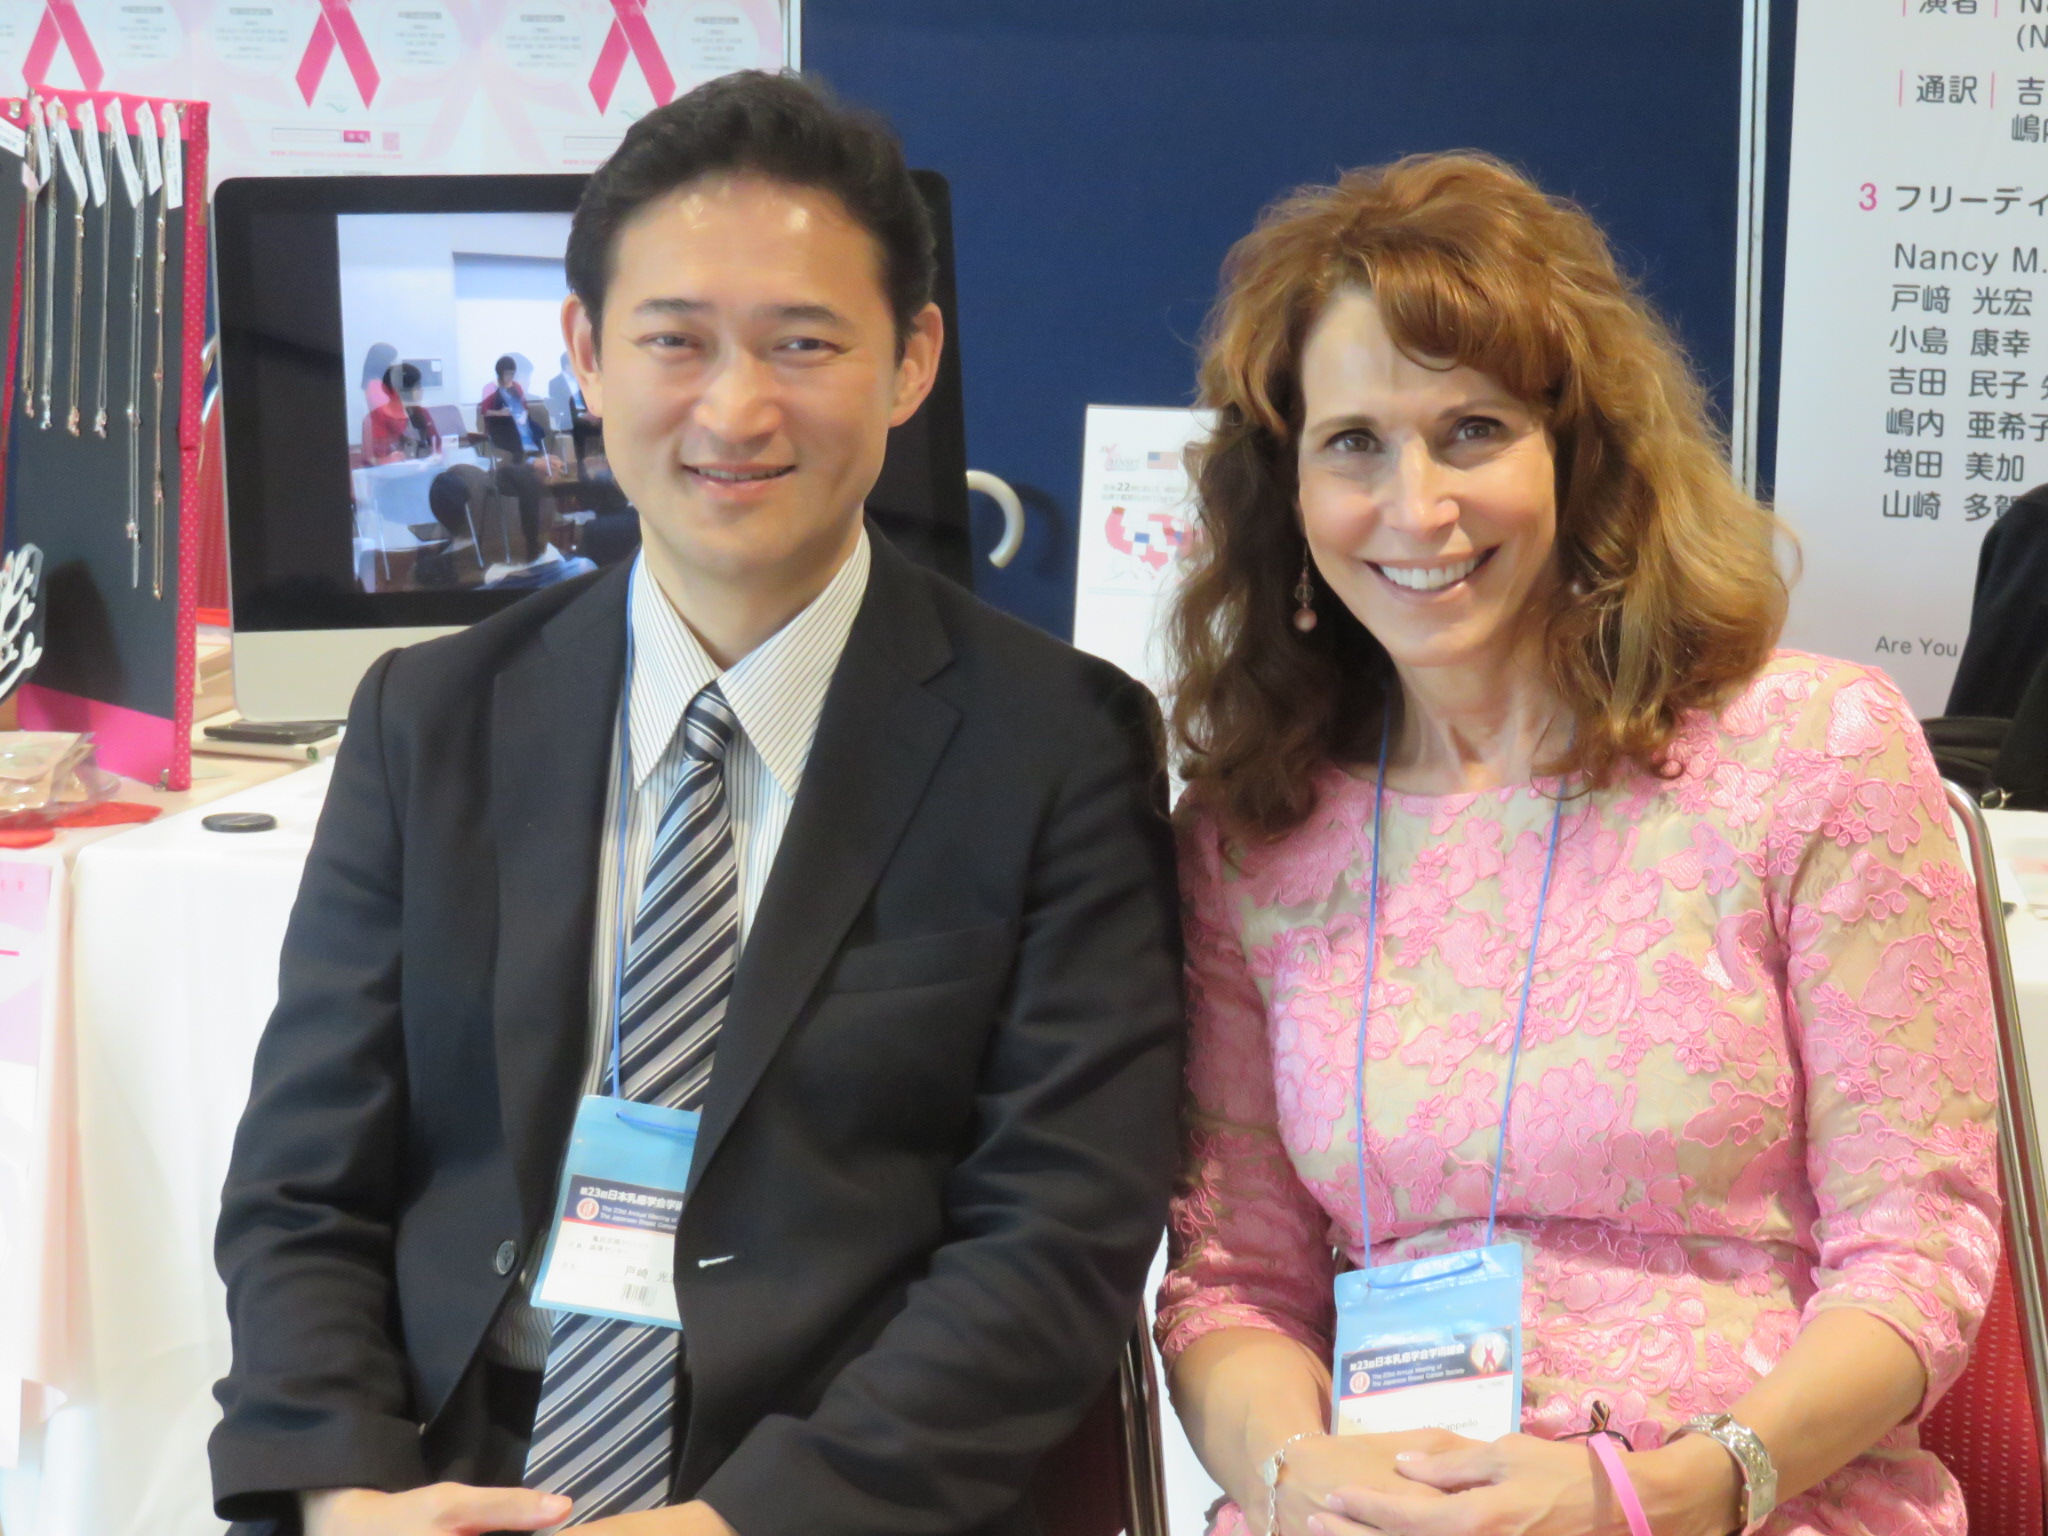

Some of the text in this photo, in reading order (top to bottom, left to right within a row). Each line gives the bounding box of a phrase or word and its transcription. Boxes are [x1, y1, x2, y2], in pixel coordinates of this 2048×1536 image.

[1916, 74, 1978, 105] 通訳
[1858, 182, 1878, 212] 3
[1894, 242, 2048, 276] Nancy M.
[1972, 286, 2033, 317] 光宏
[1889, 324, 2031, 359] 小島 康幸
[1888, 366, 1947, 397] 吉田
[1968, 369, 2029, 400] 民子
[1886, 407, 2048, 442] 嶋内 亜希子
[1884, 448, 2025, 483] 増田 美加
[1882, 489, 1942, 521] 山崎
[1875, 635, 1958, 657] Are You
